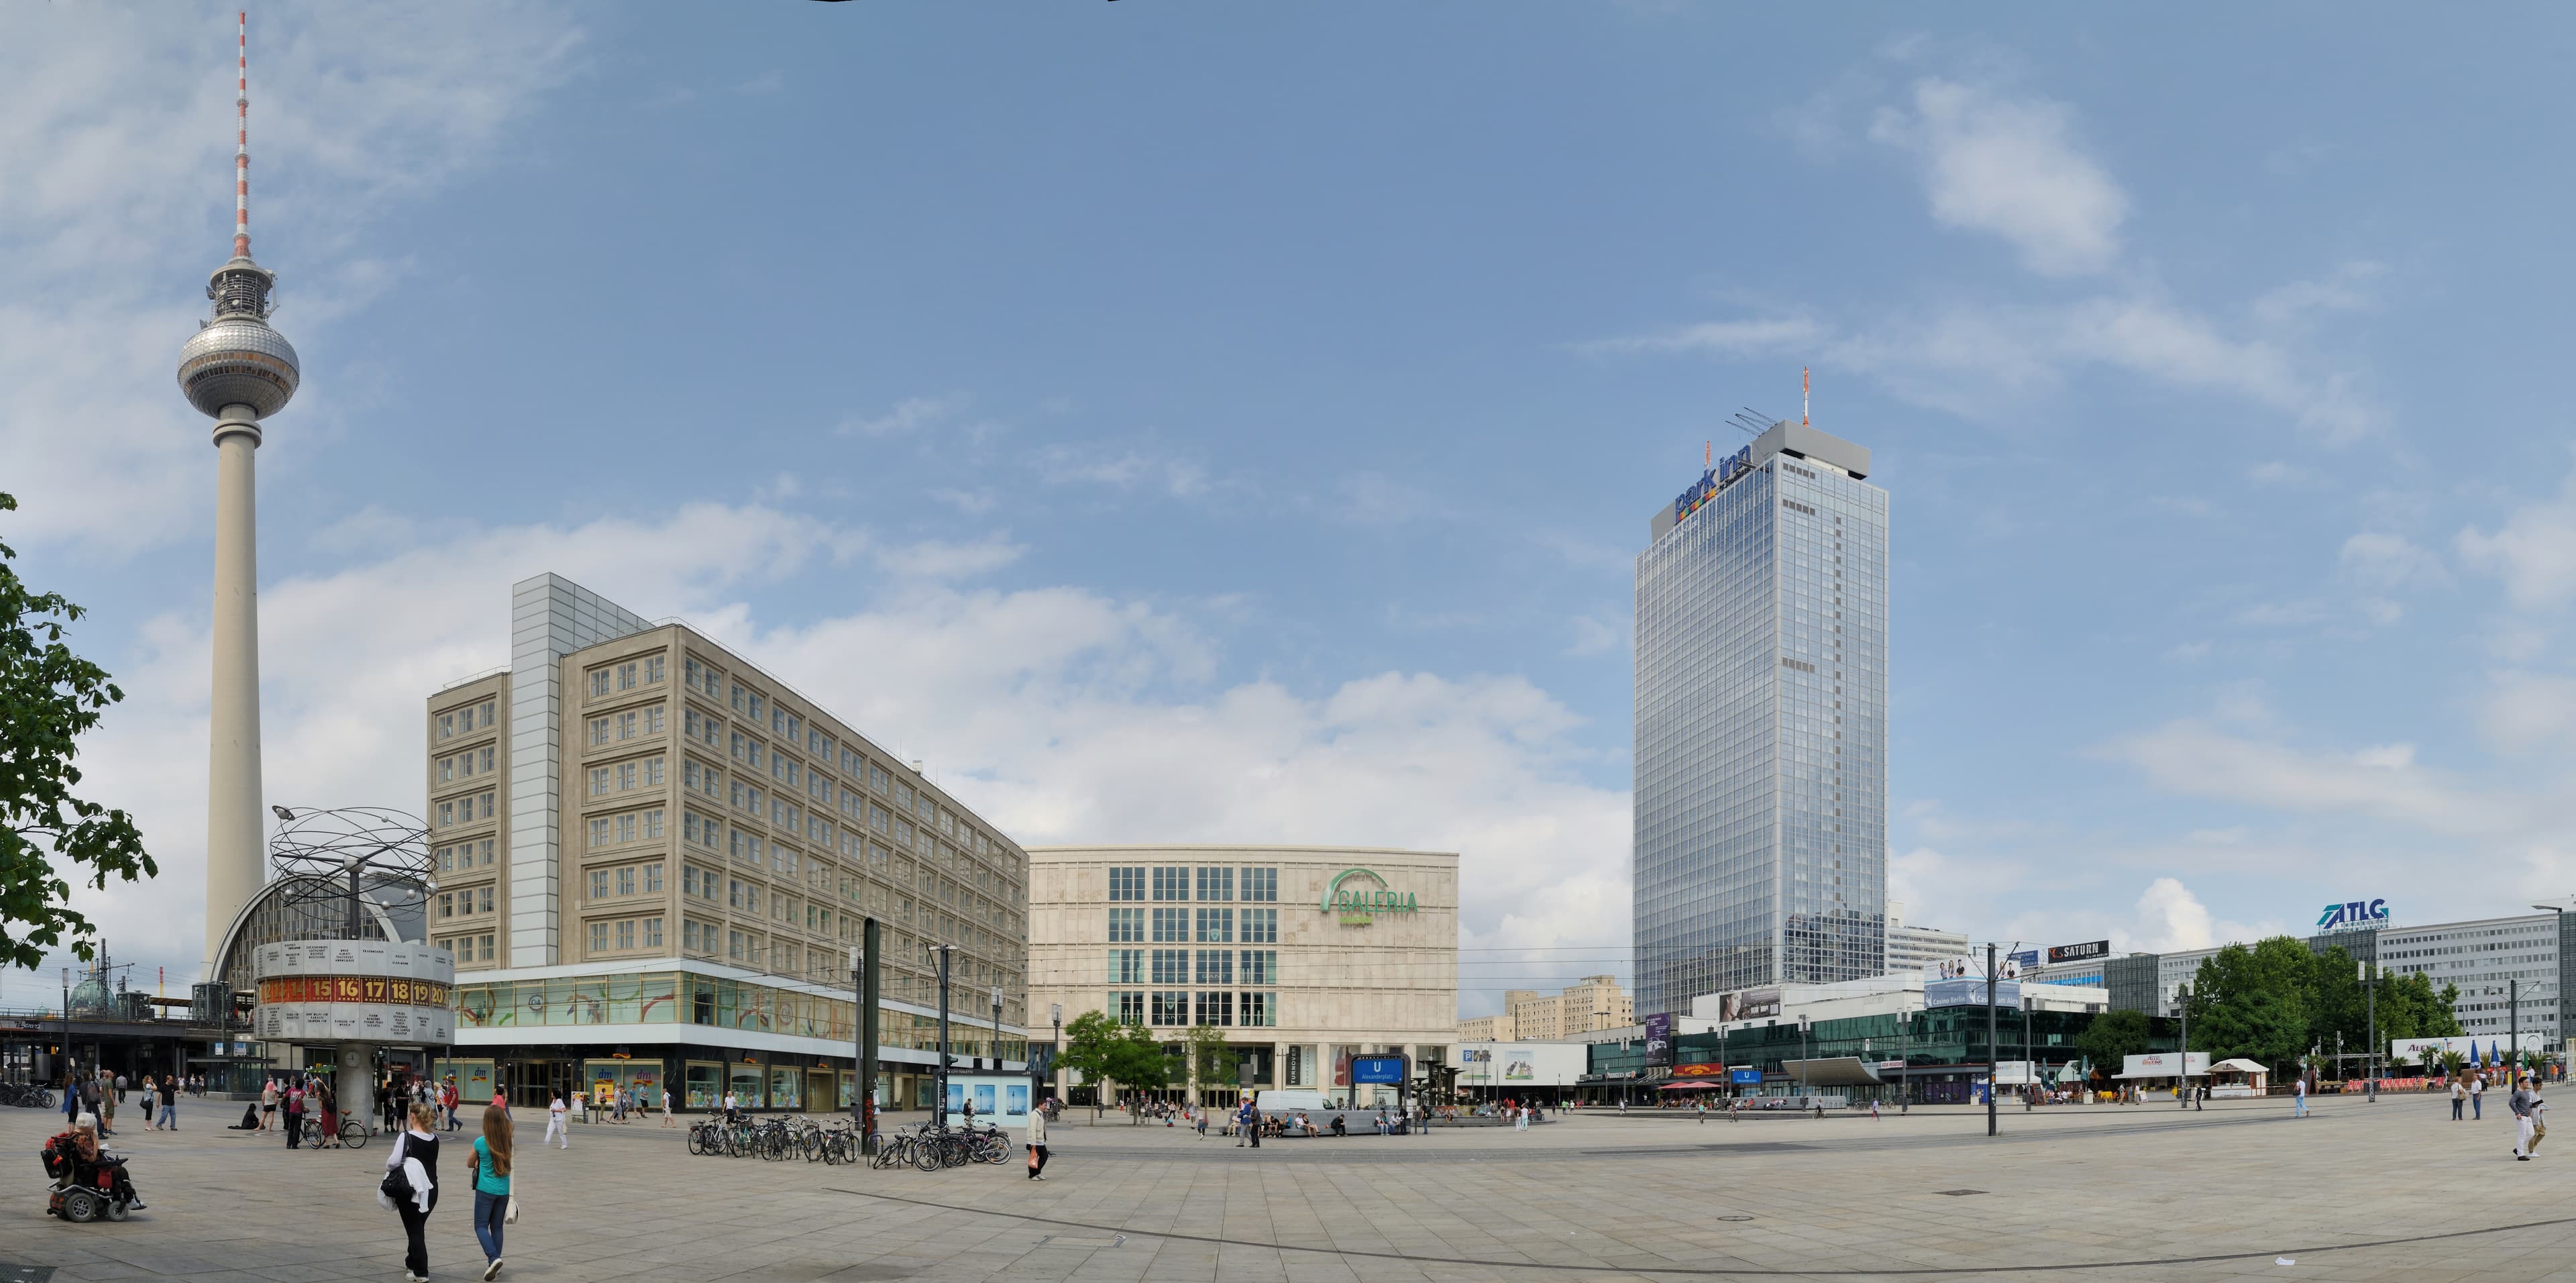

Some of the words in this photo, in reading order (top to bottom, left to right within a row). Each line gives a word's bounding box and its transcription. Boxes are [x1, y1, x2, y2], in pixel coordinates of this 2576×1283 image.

[1674, 469, 1716, 524] park
[1719, 444, 1751, 482] inn
[1338, 890, 1418, 913] GALERIA
[2064, 943, 2098, 957] SATURN
[313, 981, 331, 996] 15
[338, 980, 359, 997] 16
[365, 981, 385, 998] 17
[392, 983, 409, 1000] 18
[414, 985, 428, 1001] 19
[431, 987, 443, 1004] 20
[1977, 995, 1988, 1003] Casi
[474, 1067, 486, 1076] dm
[1374, 1062, 1381, 1073] U
[598, 1068, 612, 1079] dm
[637, 1069, 651, 1080] dm
